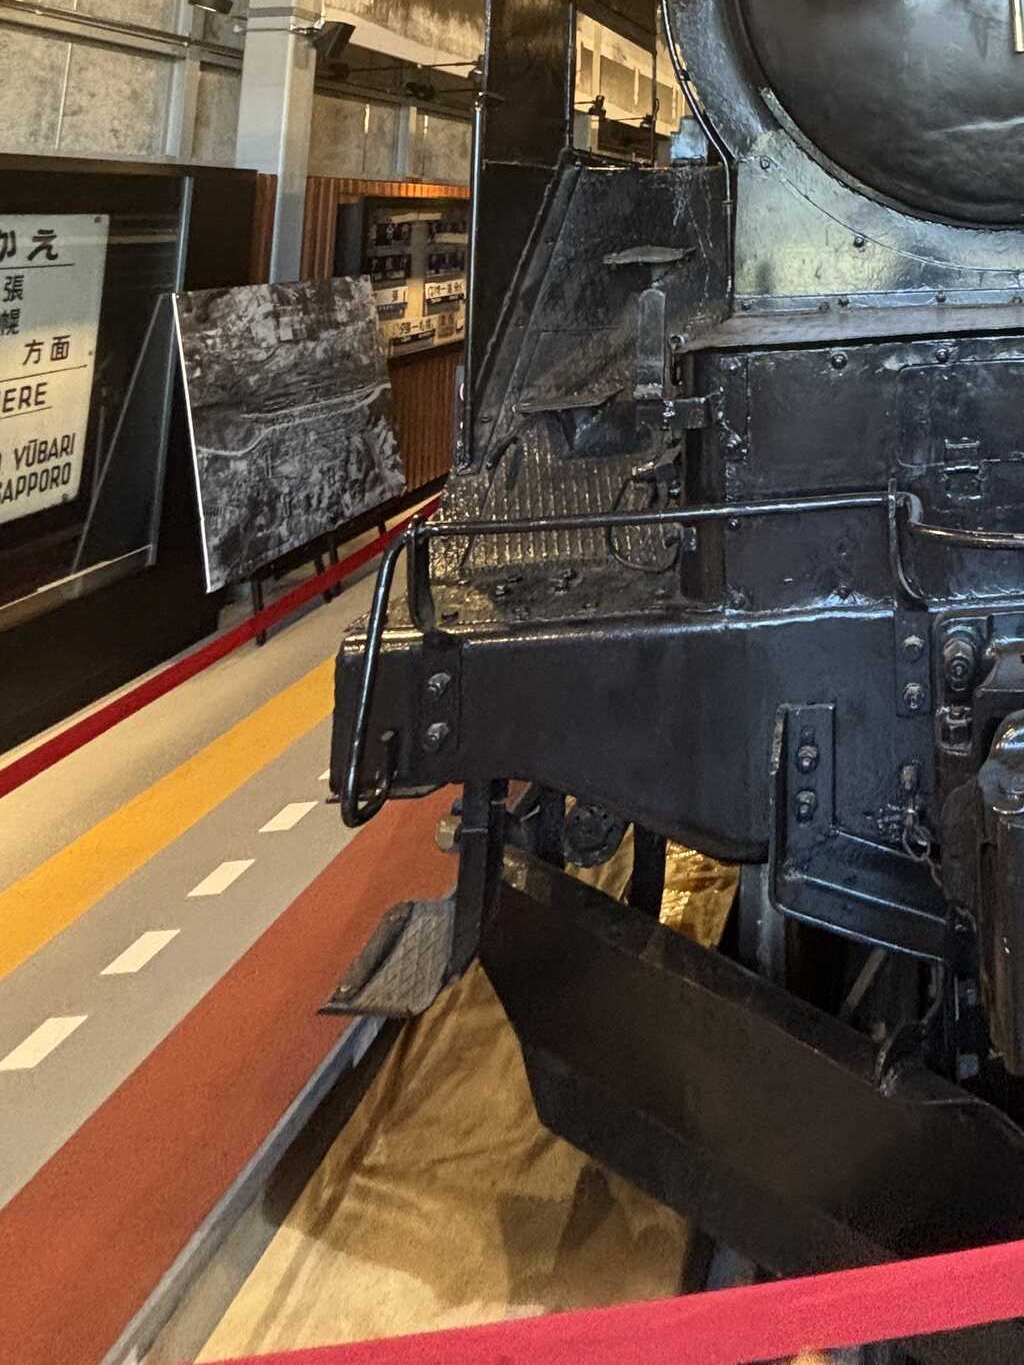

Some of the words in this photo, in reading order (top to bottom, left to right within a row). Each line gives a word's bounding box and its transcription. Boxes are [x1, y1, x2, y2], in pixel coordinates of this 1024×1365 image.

[2, 275, 24, 303] 張
[23, 336, 70, 365] 方面
[0, 383, 48, 412] ERE
[14, 434, 75, 470] YŪBARI
